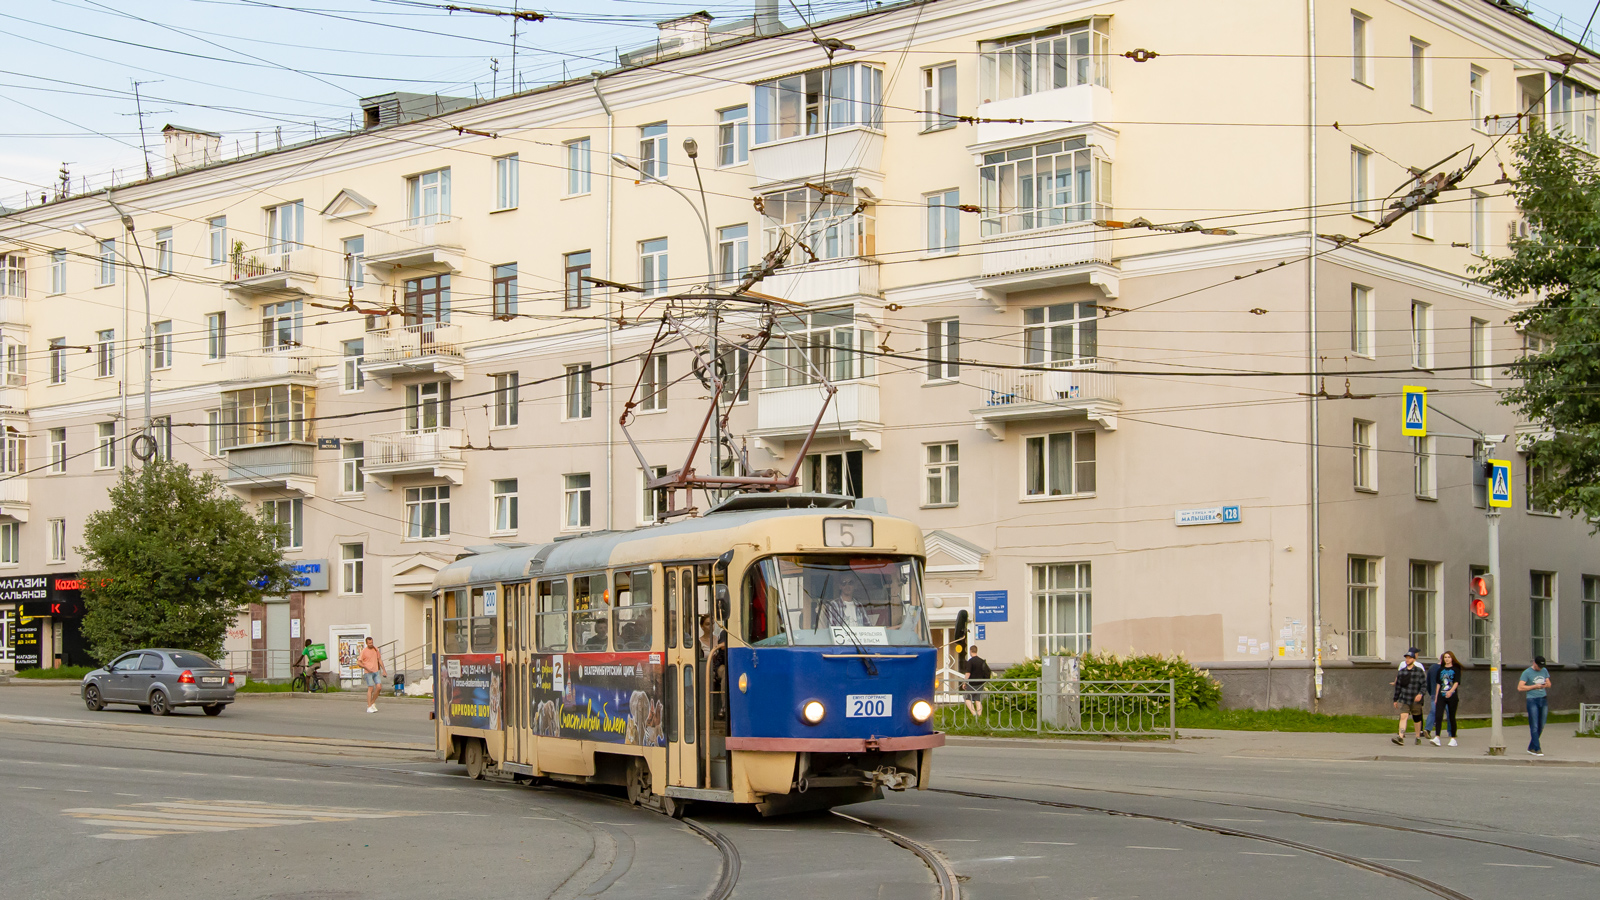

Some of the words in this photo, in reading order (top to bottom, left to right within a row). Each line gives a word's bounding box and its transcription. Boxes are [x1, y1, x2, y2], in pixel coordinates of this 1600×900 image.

[1225, 508, 1238, 520] 128
[840, 523, 854, 547] 5
[0, 578, 46, 588] МАГАЗИН
[486, 592, 495, 606] 200
[834, 629, 845, 644] 5
[555, 662, 562, 678] 2
[584, 664, 622, 676] ЕКАТЕРИНБУРГСКИЙ
[624, 666, 634, 676] ЦИРК
[451, 704, 477, 717] ЦИРКОВОЕ
[854, 700, 884, 716] 200
[560, 698, 600, 732] Счастливый
[603, 702, 626, 734] билет
